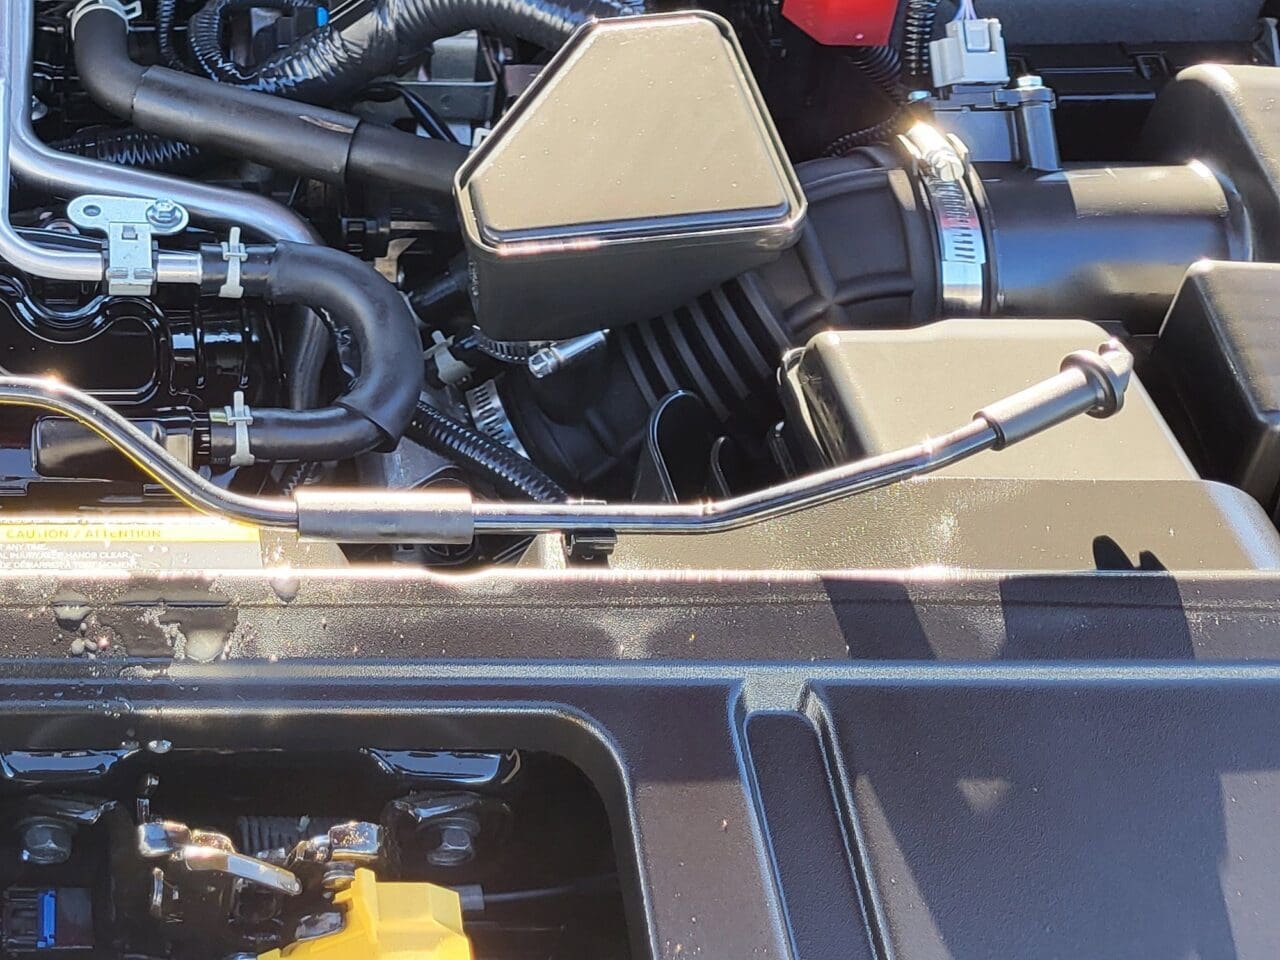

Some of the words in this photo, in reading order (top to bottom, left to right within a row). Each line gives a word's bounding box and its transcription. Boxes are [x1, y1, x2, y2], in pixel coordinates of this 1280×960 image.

[6, 529, 68, 539] CAUION
[5, 543, 25, 552] ANY
[65, 552, 97, 560] HANDS
